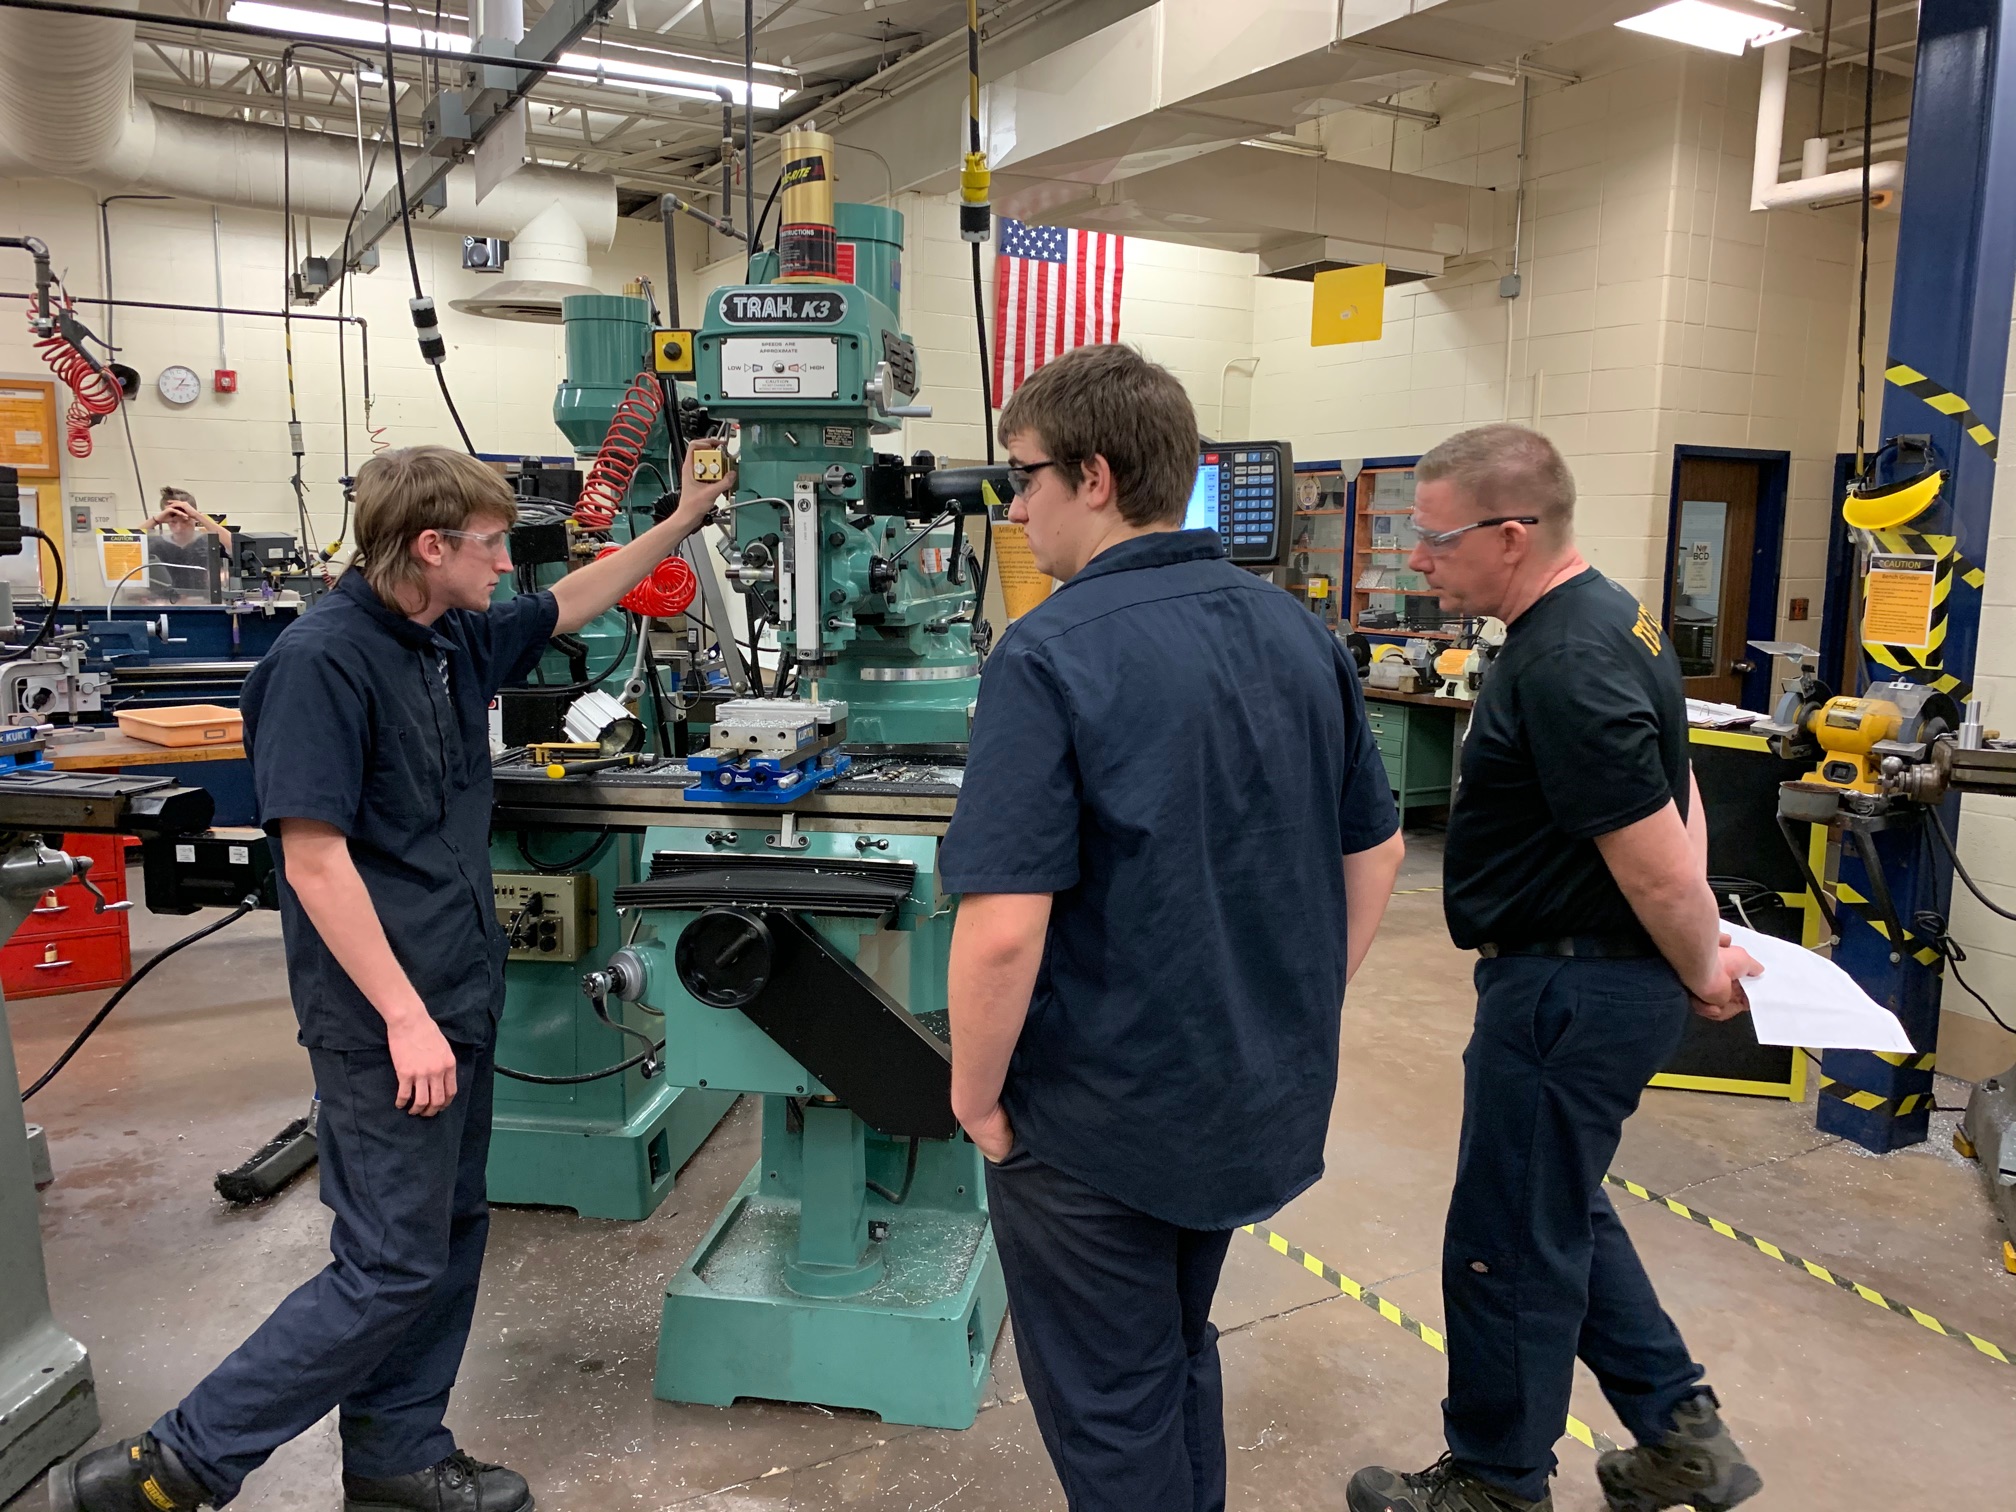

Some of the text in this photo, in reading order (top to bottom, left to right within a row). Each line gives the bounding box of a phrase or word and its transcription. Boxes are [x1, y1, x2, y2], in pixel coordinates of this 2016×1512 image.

[801, 300, 831, 318] K3
[1693, 552, 1710, 560] BCD
[1884, 560, 1921, 569] CAUTION
[5, 730, 29, 742] KURT
